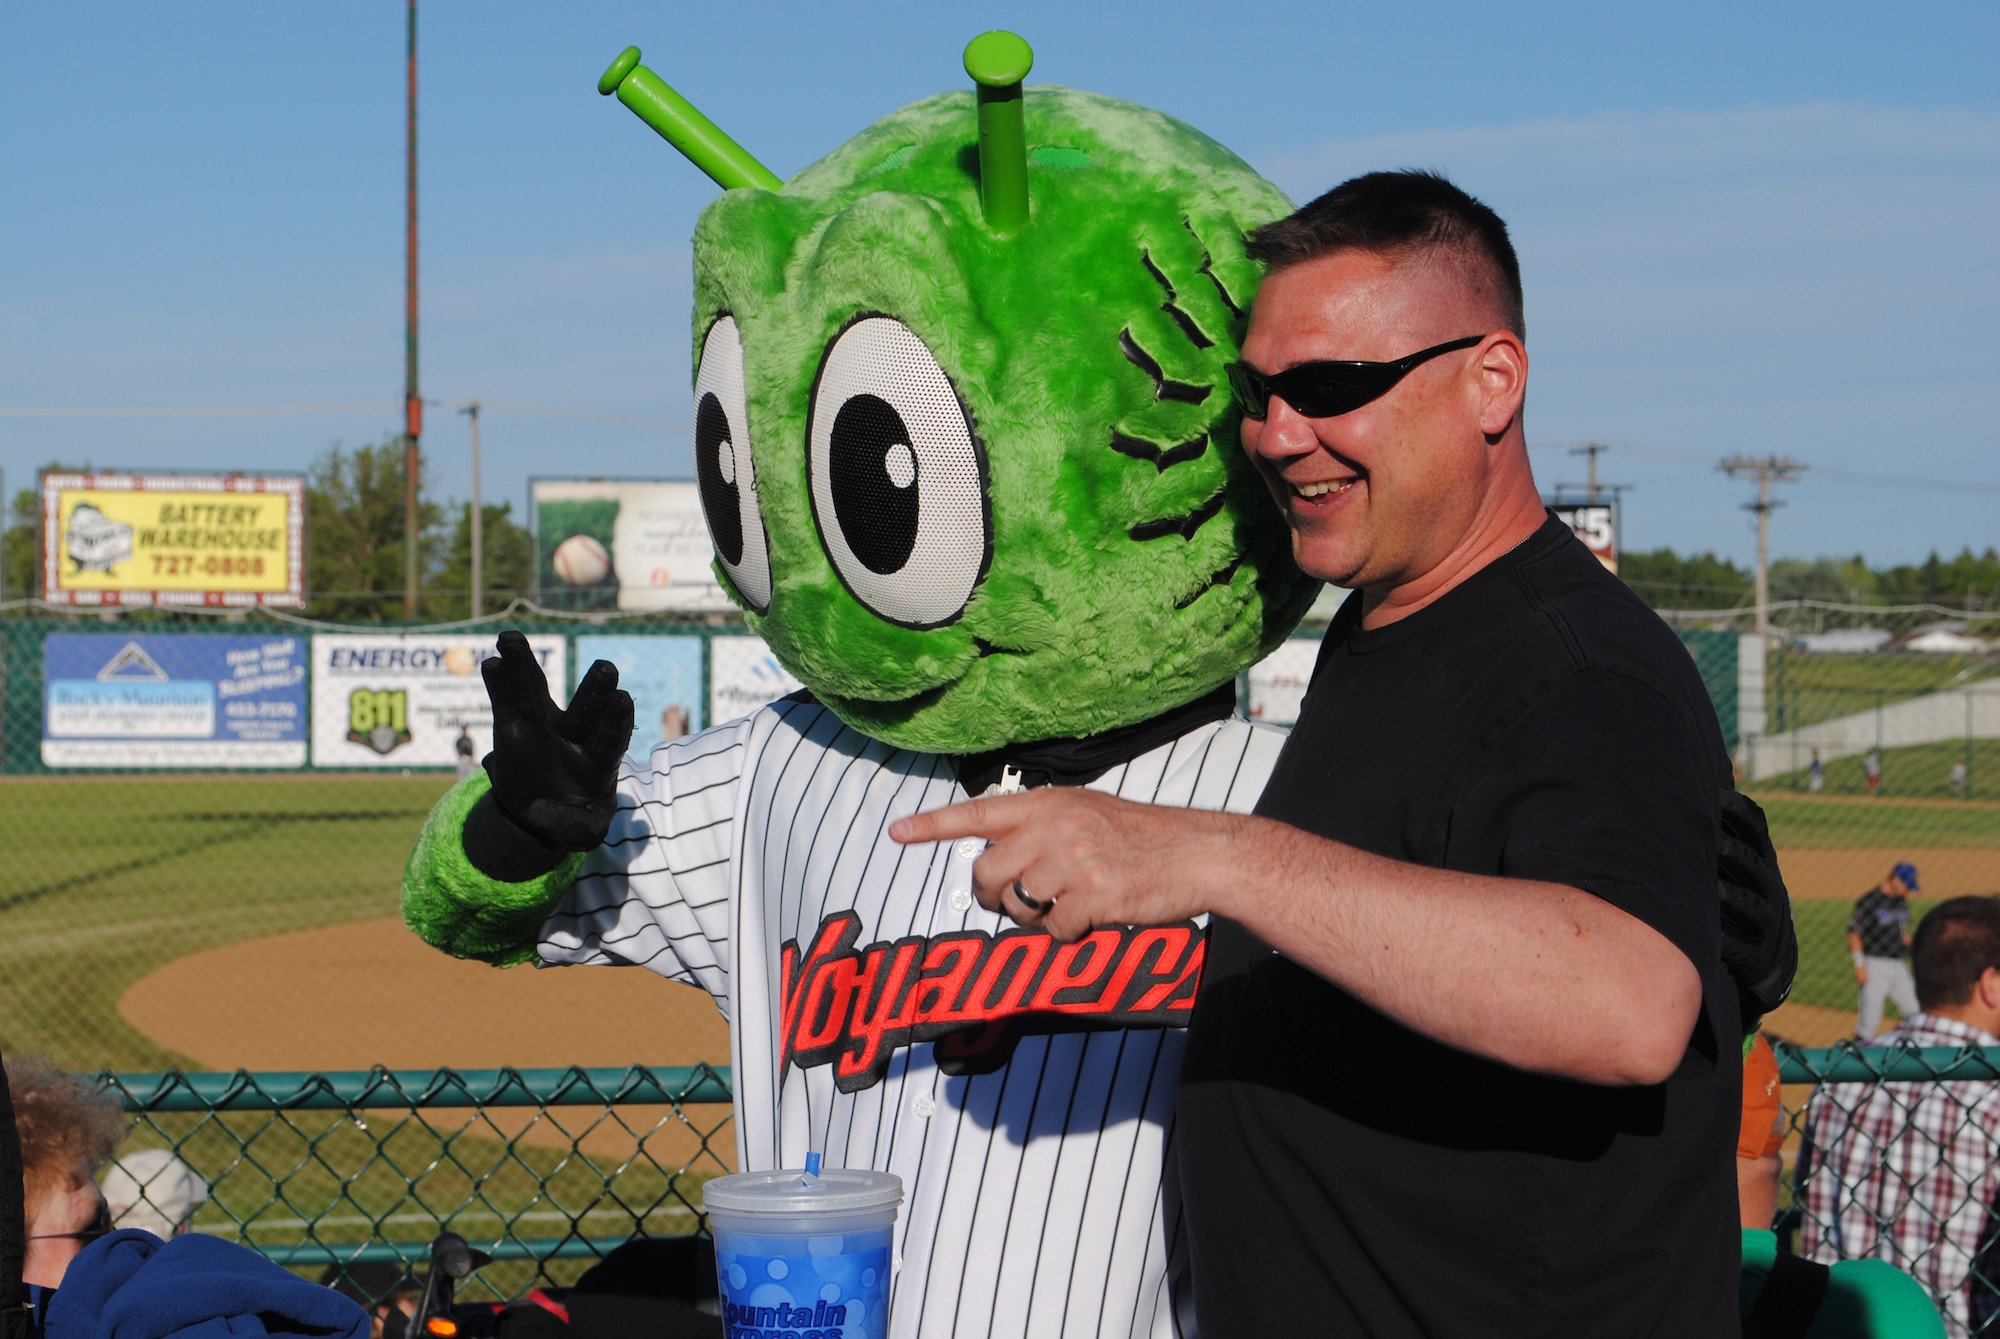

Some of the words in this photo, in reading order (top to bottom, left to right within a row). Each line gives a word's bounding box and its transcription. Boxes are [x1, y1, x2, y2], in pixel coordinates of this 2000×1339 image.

[159, 503, 263, 523] BATTERY
[139, 528, 281, 549] WAREHOUSE
[330, 648, 444, 668] ENERGY
[350, 688, 407, 733] 811
